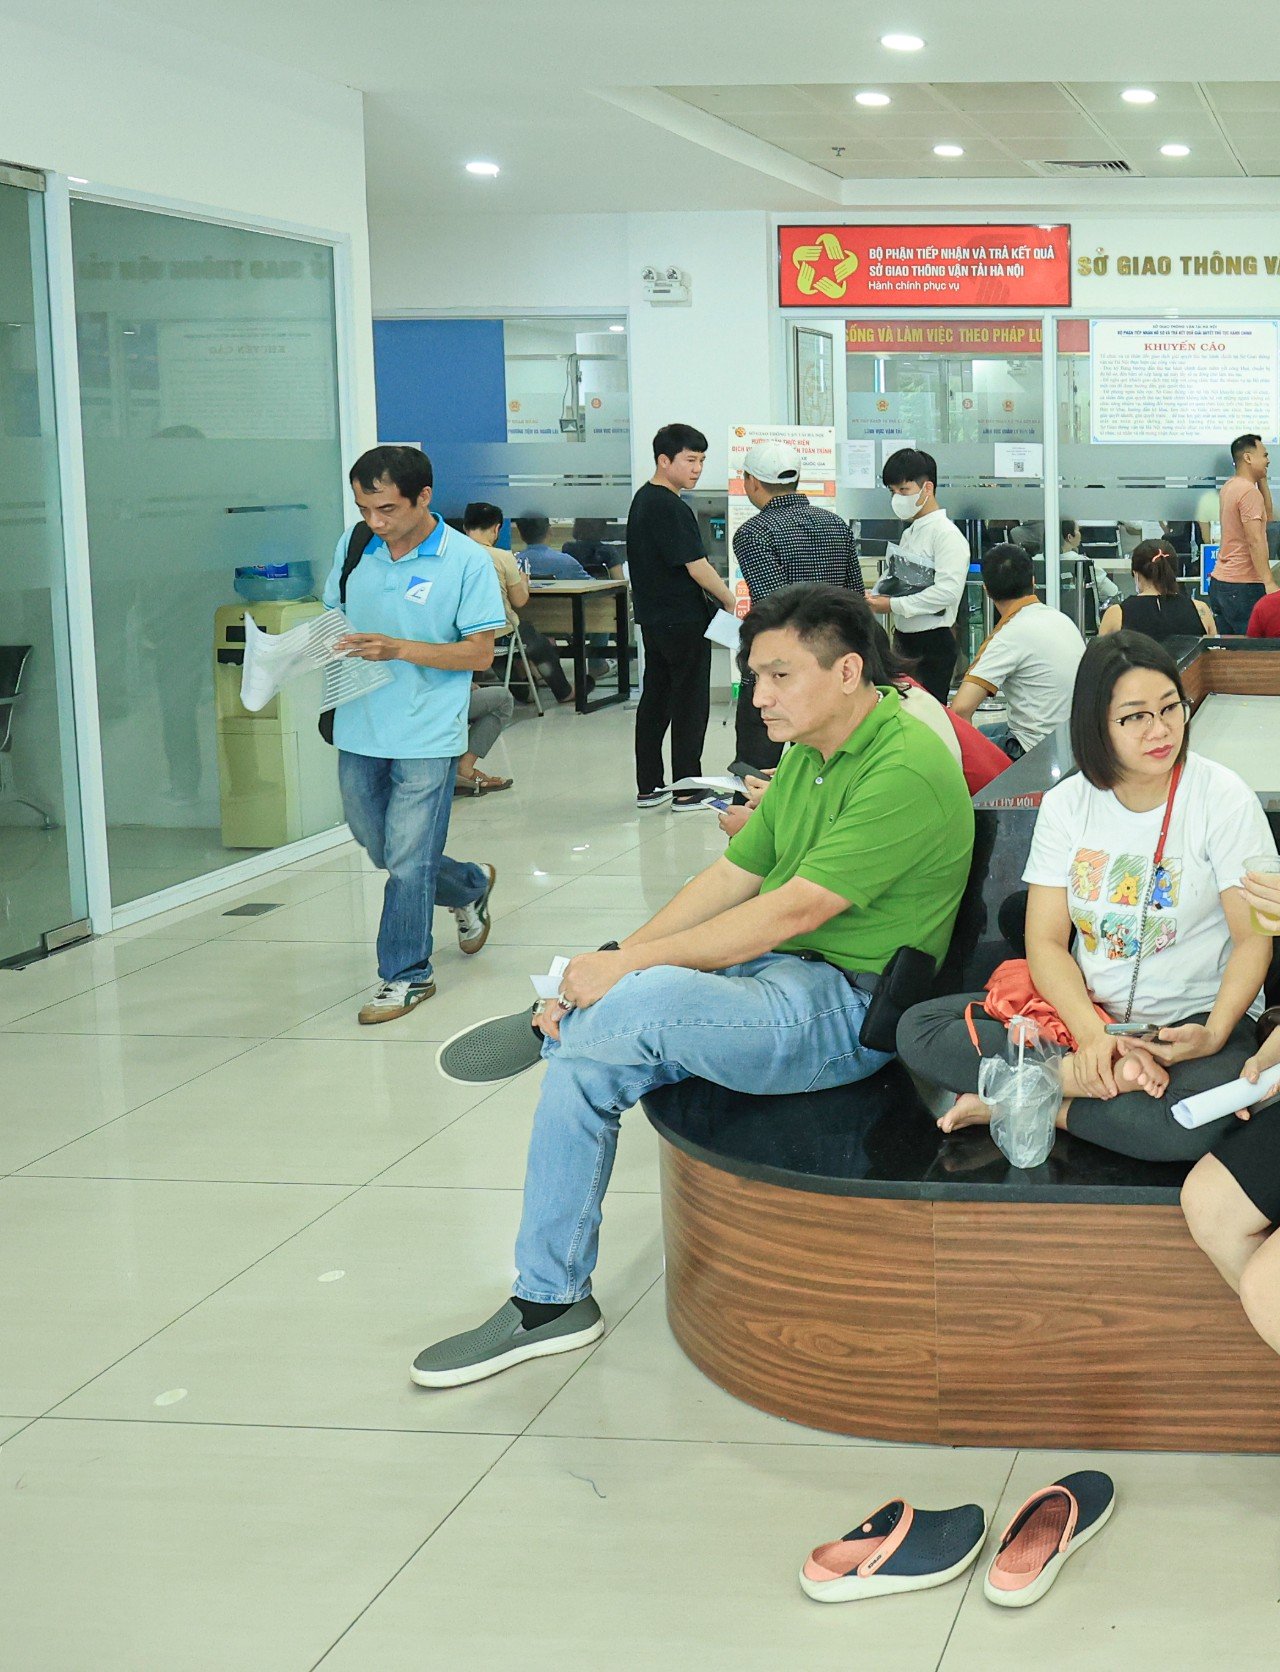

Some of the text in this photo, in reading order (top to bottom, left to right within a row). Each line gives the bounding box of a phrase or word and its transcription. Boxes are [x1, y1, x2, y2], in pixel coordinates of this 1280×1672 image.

[869, 244, 1055, 262] BỘ PHẬN TIẾP NHẬN VÀ TRẢ KẾT QUẢ
[1077, 247, 1110, 276] SỞ
[1116, 255, 1172, 276] GIAO
[1179, 250, 1258, 276] THÔNG
[869, 262, 1024, 278] SỞ GIAO THÔNG VẬN TẢI HÀ NỘI
[868, 280, 960, 293] Hành chính phục vụ
[877, 325, 894, 342] VÀ
[896, 325, 923, 342] LÀM
[927, 326, 954, 345] VIỆC
[959, 328, 989, 343] THEO
[993, 325, 1025, 342] PHÁP
[1144, 340, 1196, 351] KHUYẾN
